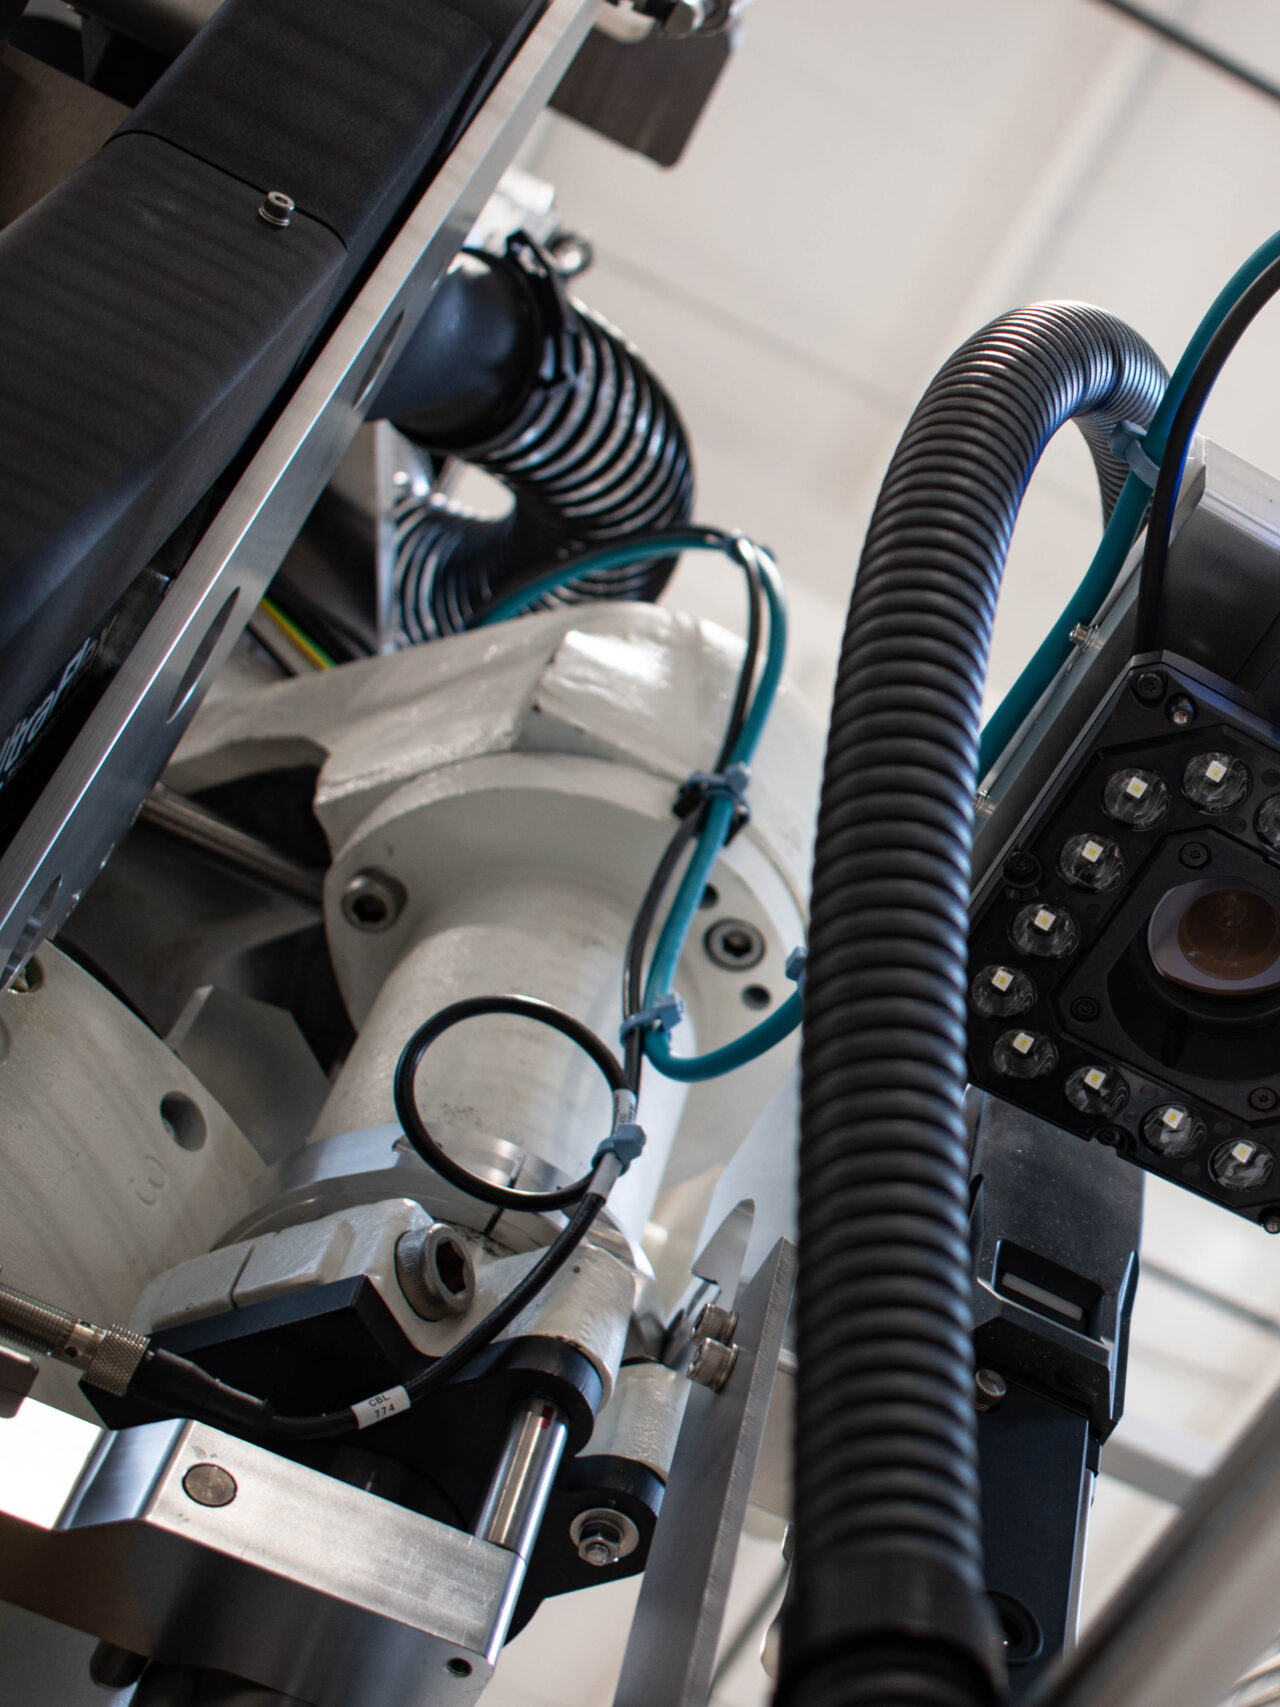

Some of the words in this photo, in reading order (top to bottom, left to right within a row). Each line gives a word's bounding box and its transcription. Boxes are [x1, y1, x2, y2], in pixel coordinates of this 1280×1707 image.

[0, 613, 119, 776] ltraFlex
[368, 1393, 391, 1407] CBL
[374, 1403, 396, 1418] 774
